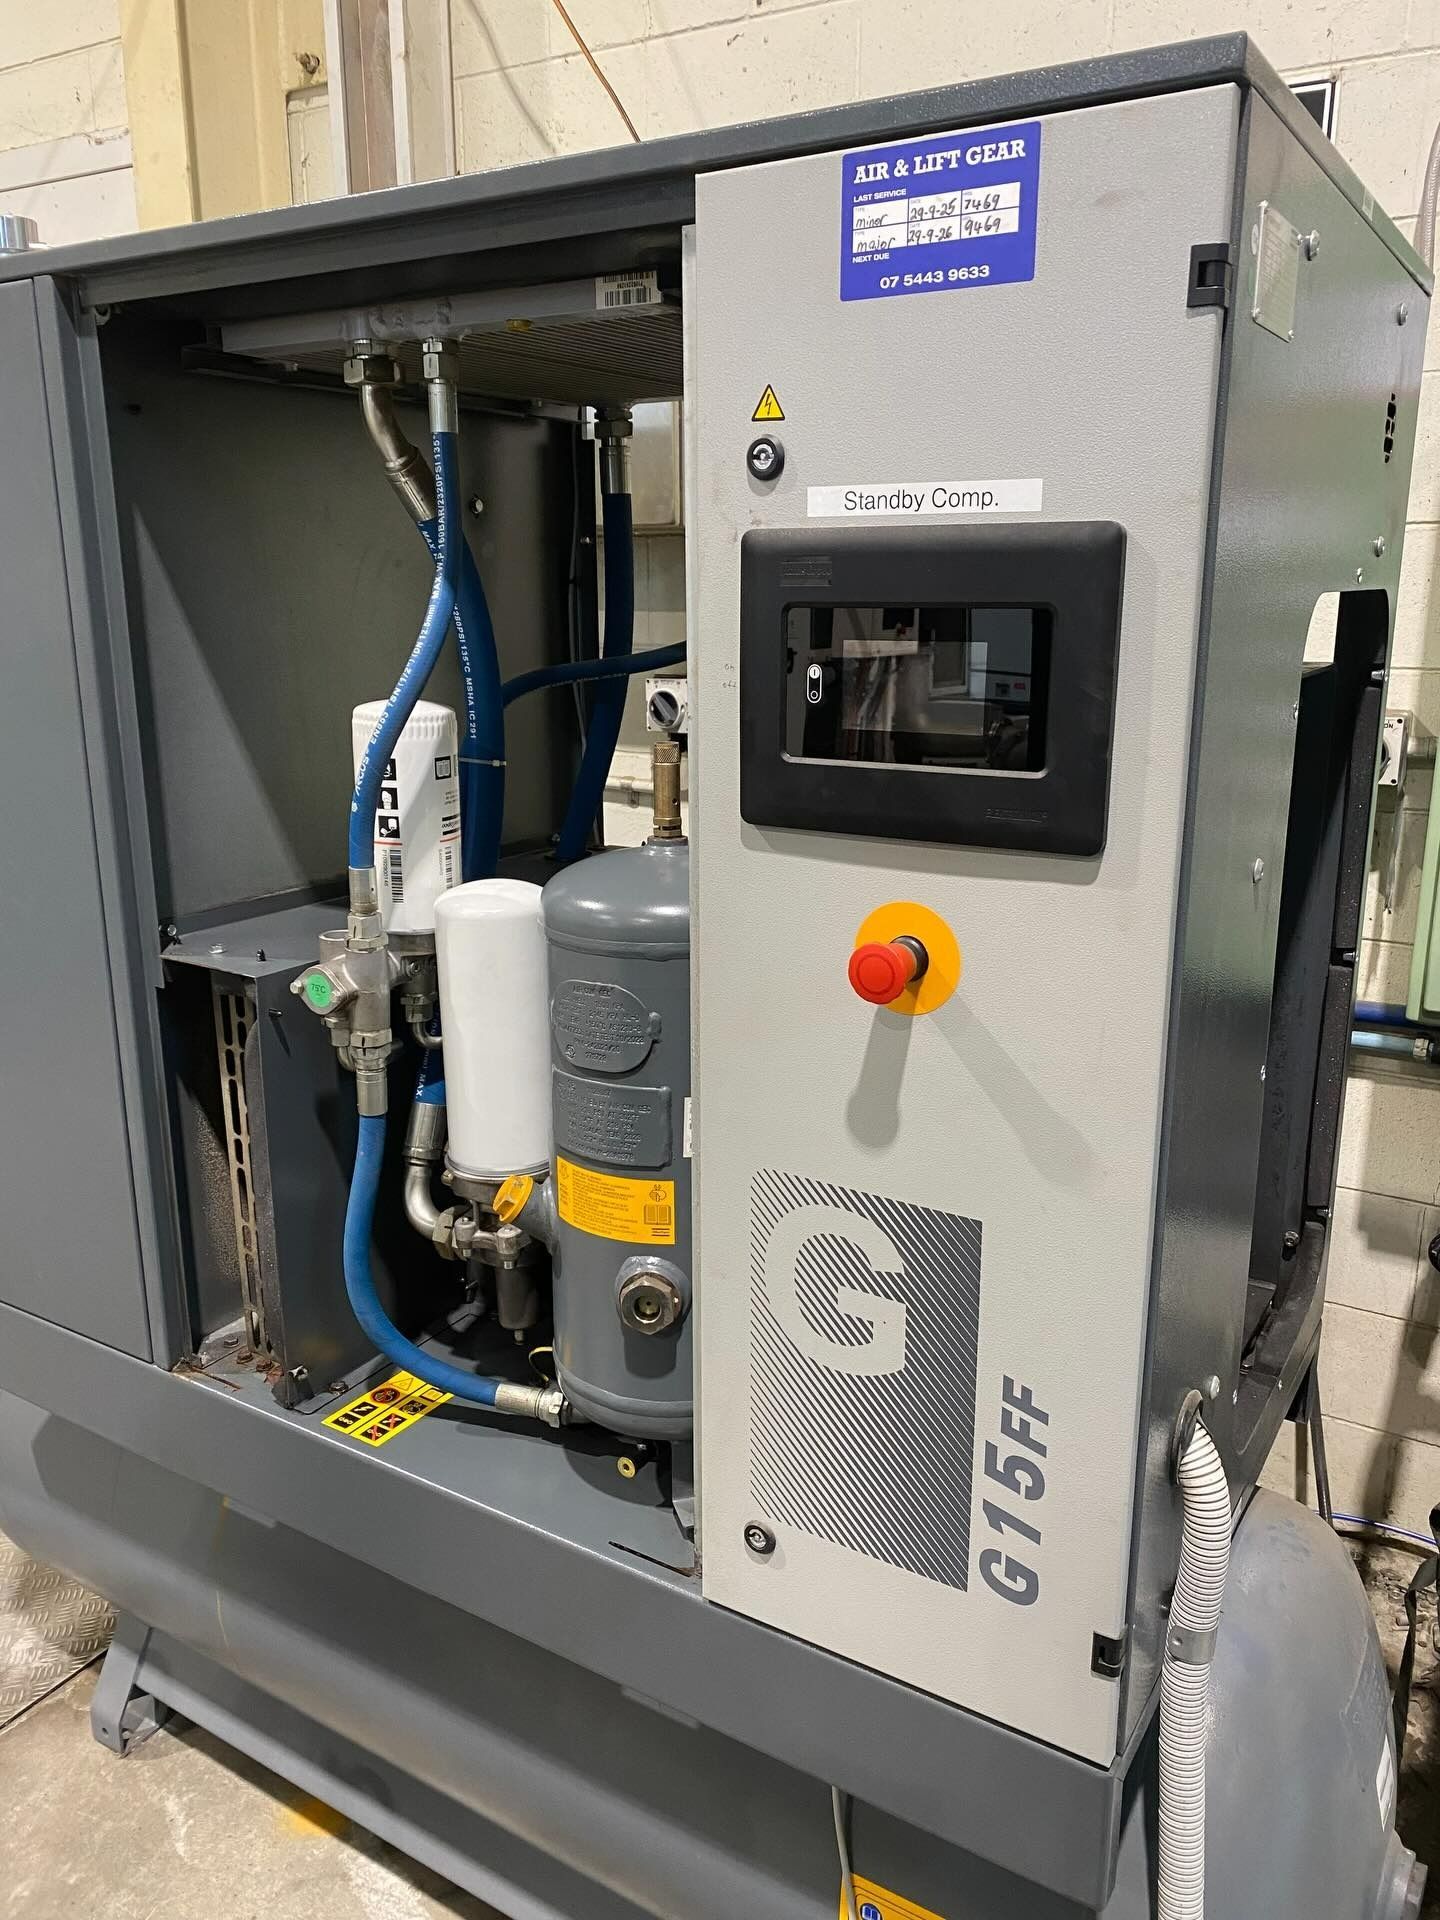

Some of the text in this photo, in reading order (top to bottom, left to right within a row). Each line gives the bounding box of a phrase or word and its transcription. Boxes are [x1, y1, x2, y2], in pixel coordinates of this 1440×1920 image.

[854, 139, 1026, 184] AIR & LIFT GEAR
[853, 188, 907, 203] LAST SERVICE
[964, 193, 1001, 211] 7469
[910, 197, 957, 221] 29-9-25
[856, 213, 888, 228] minor
[964, 215, 1002, 236] 9469
[857, 234, 896, 252] major
[908, 225, 953, 247] 29-9-26
[852, 252, 890, 264] NEXT DUE
[880, 264, 990, 289] 07 5443 9633
[844, 487, 999, 512] Standby Comp.
[465, 677, 475, 706] MSHA
[764, 1205, 906, 1377] G
